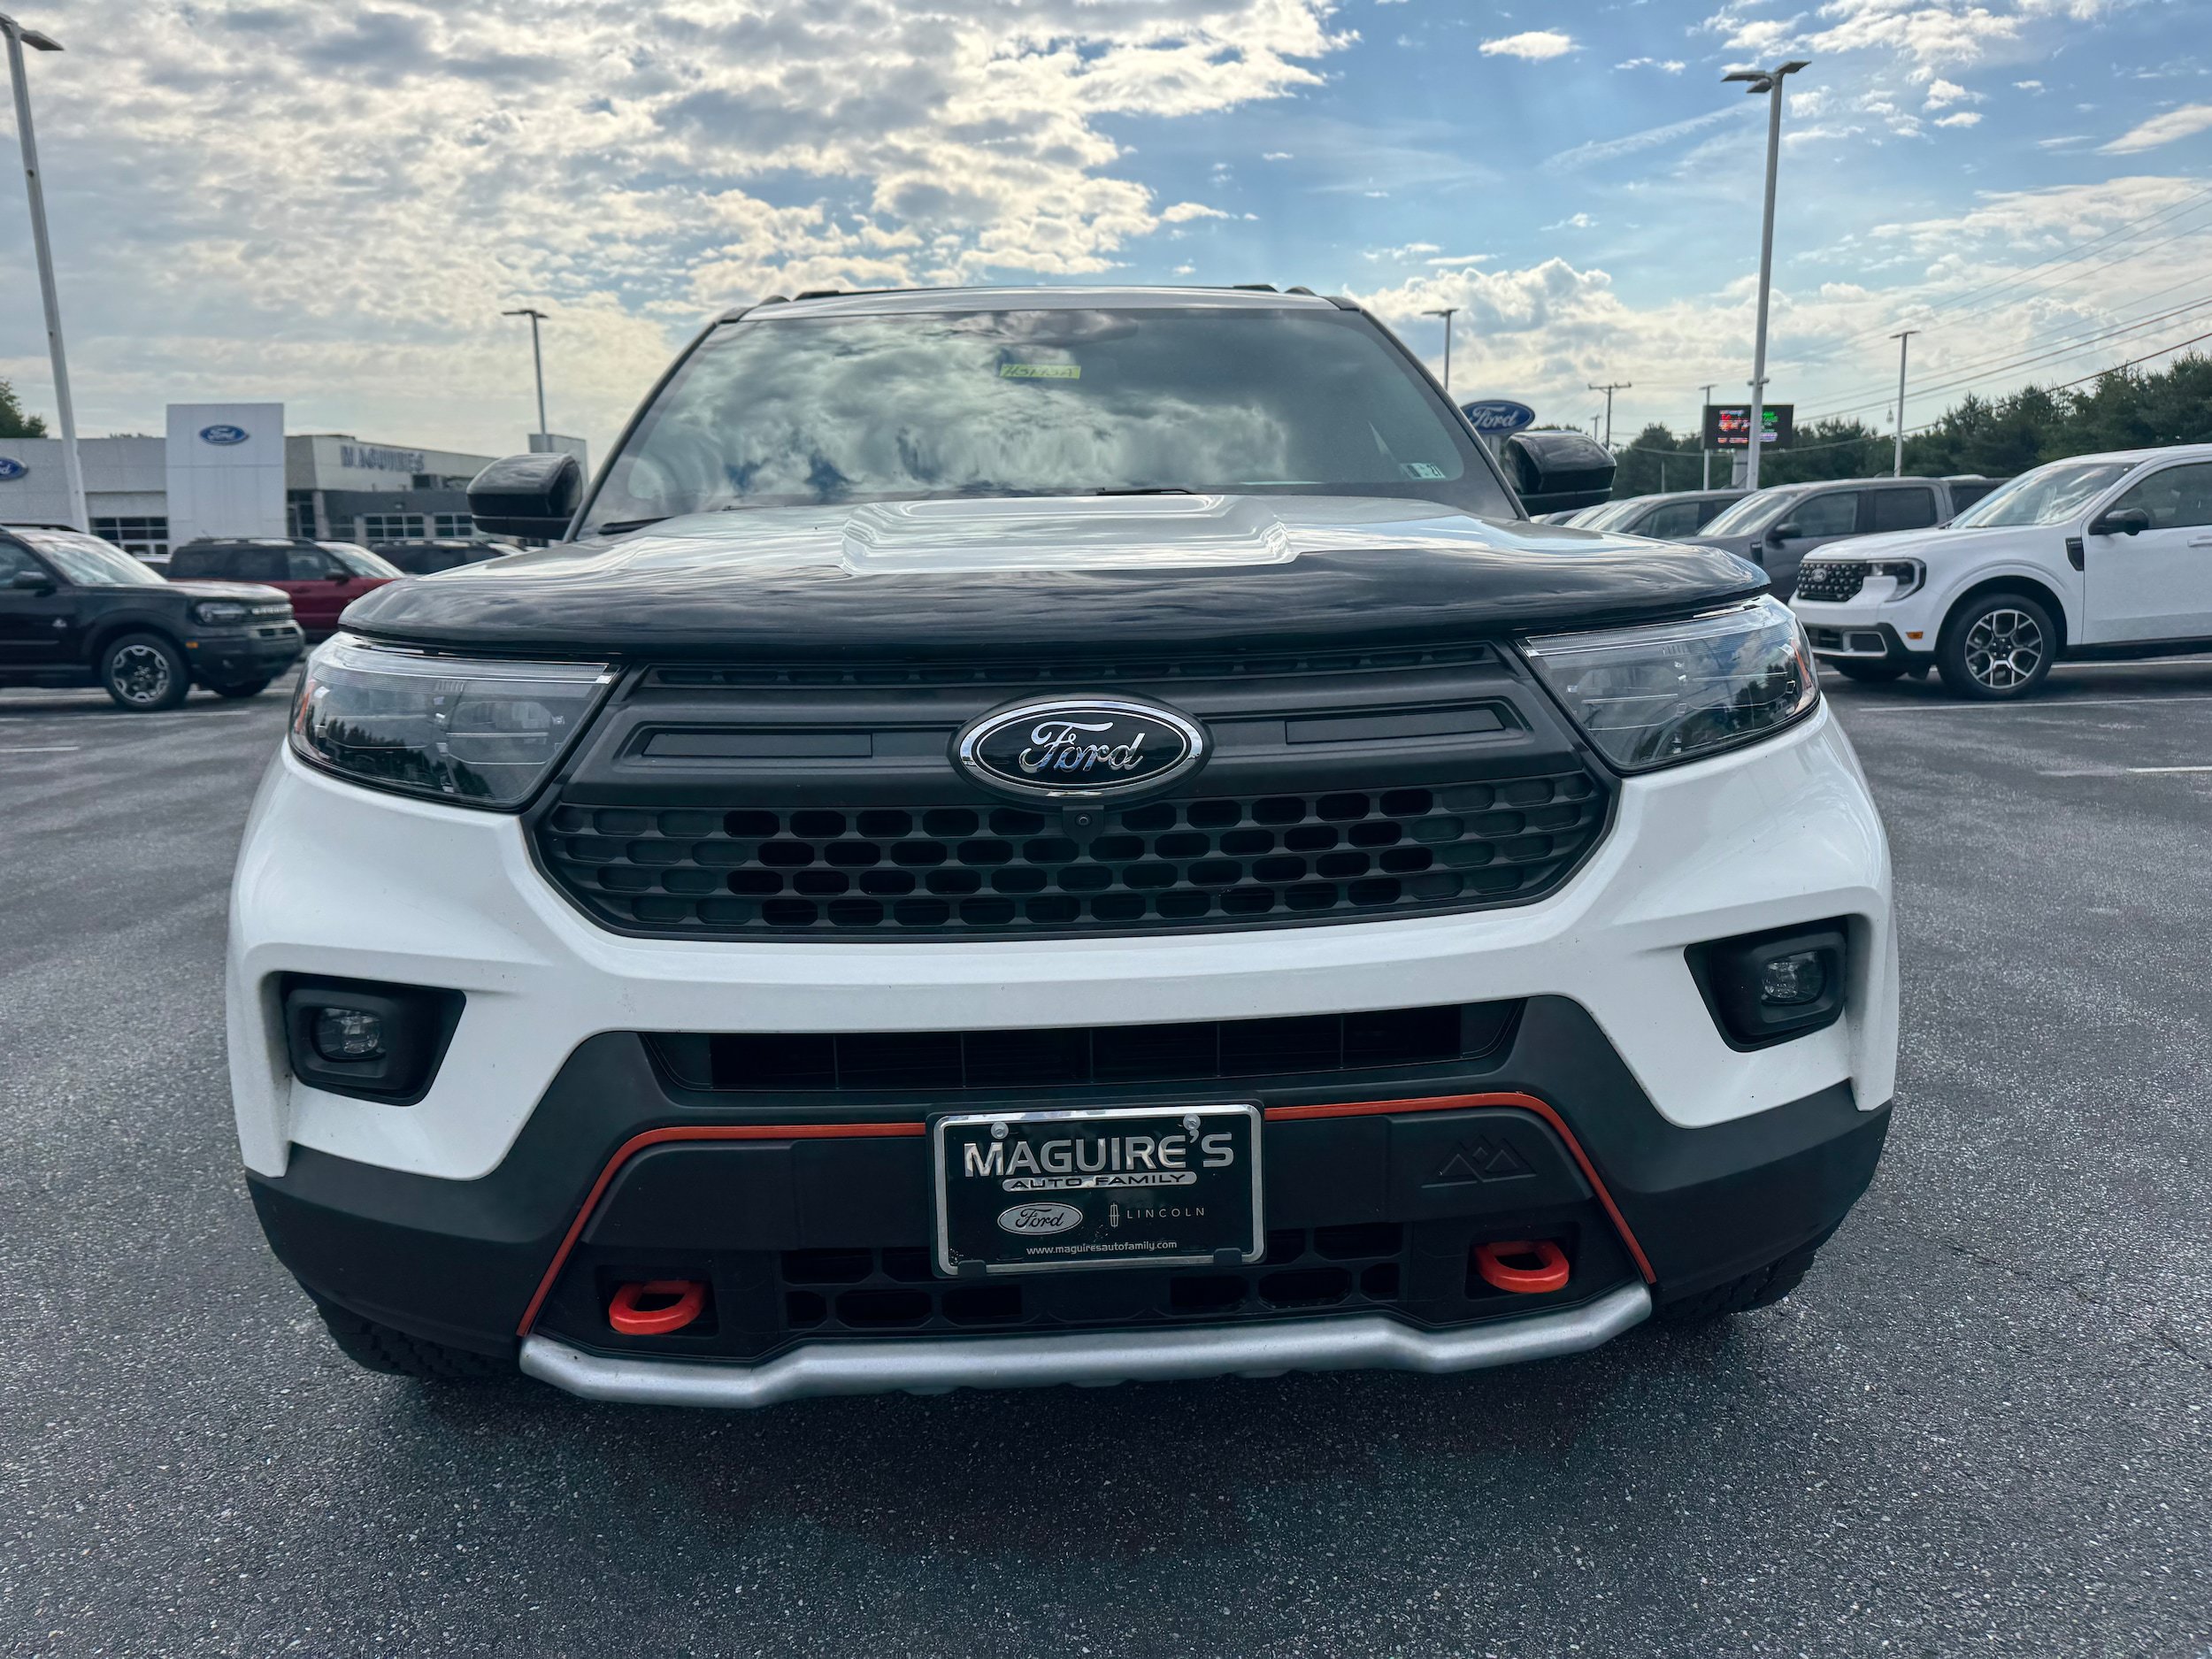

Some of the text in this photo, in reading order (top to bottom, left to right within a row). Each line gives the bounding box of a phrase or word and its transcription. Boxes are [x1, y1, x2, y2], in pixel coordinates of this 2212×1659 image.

[1469, 406, 1519, 428] Ford
[1018, 720, 1146, 772] Ford
[964, 1129, 1234, 1178] MAGUIRE'S
[1010, 1174, 1186, 1190] AUTO FAMILY
[1015, 1208, 1064, 1229] Ford
[1126, 1207, 1205, 1219] LINCOLN
[1026, 1240, 1178, 1256] www.maguiresautofamily.com
